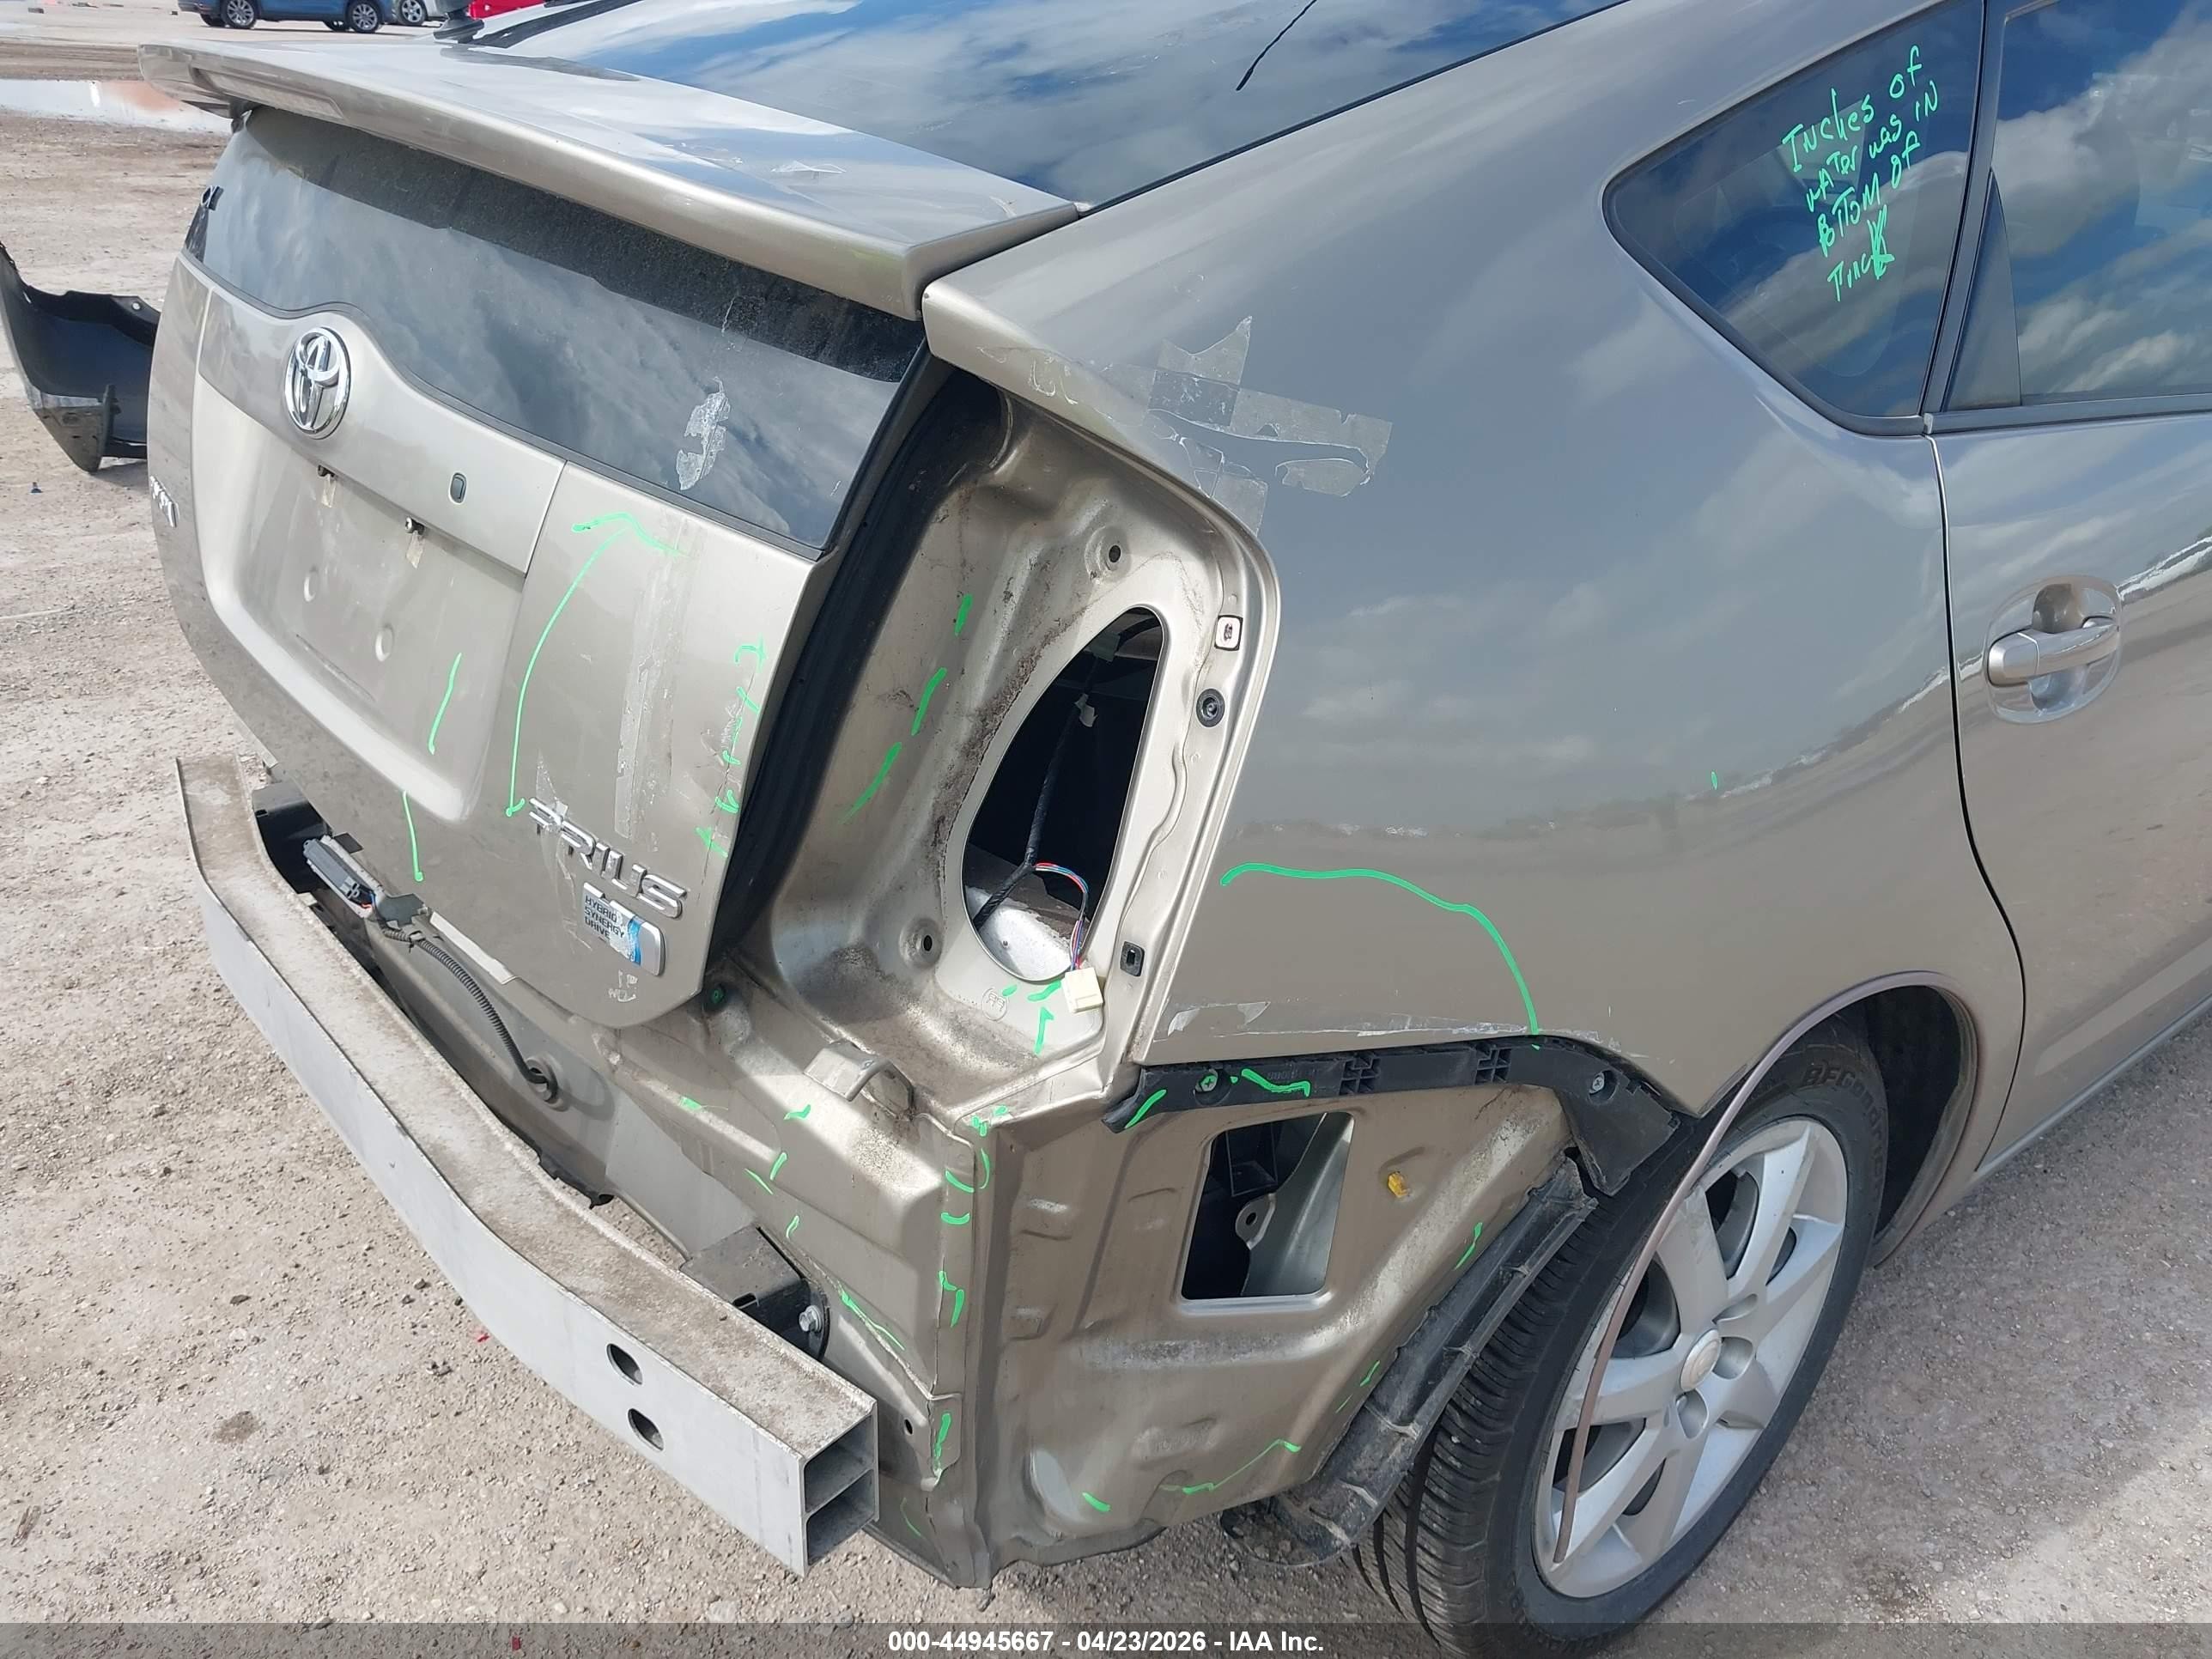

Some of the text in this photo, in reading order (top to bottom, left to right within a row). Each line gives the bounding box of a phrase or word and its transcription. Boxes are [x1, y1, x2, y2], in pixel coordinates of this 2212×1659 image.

[528, 797, 687, 919] PRIUS
[584, 905, 625, 939] SYNERGY
[585, 895, 617, 923] HYBRID
[584, 915, 611, 940] DRIVE
